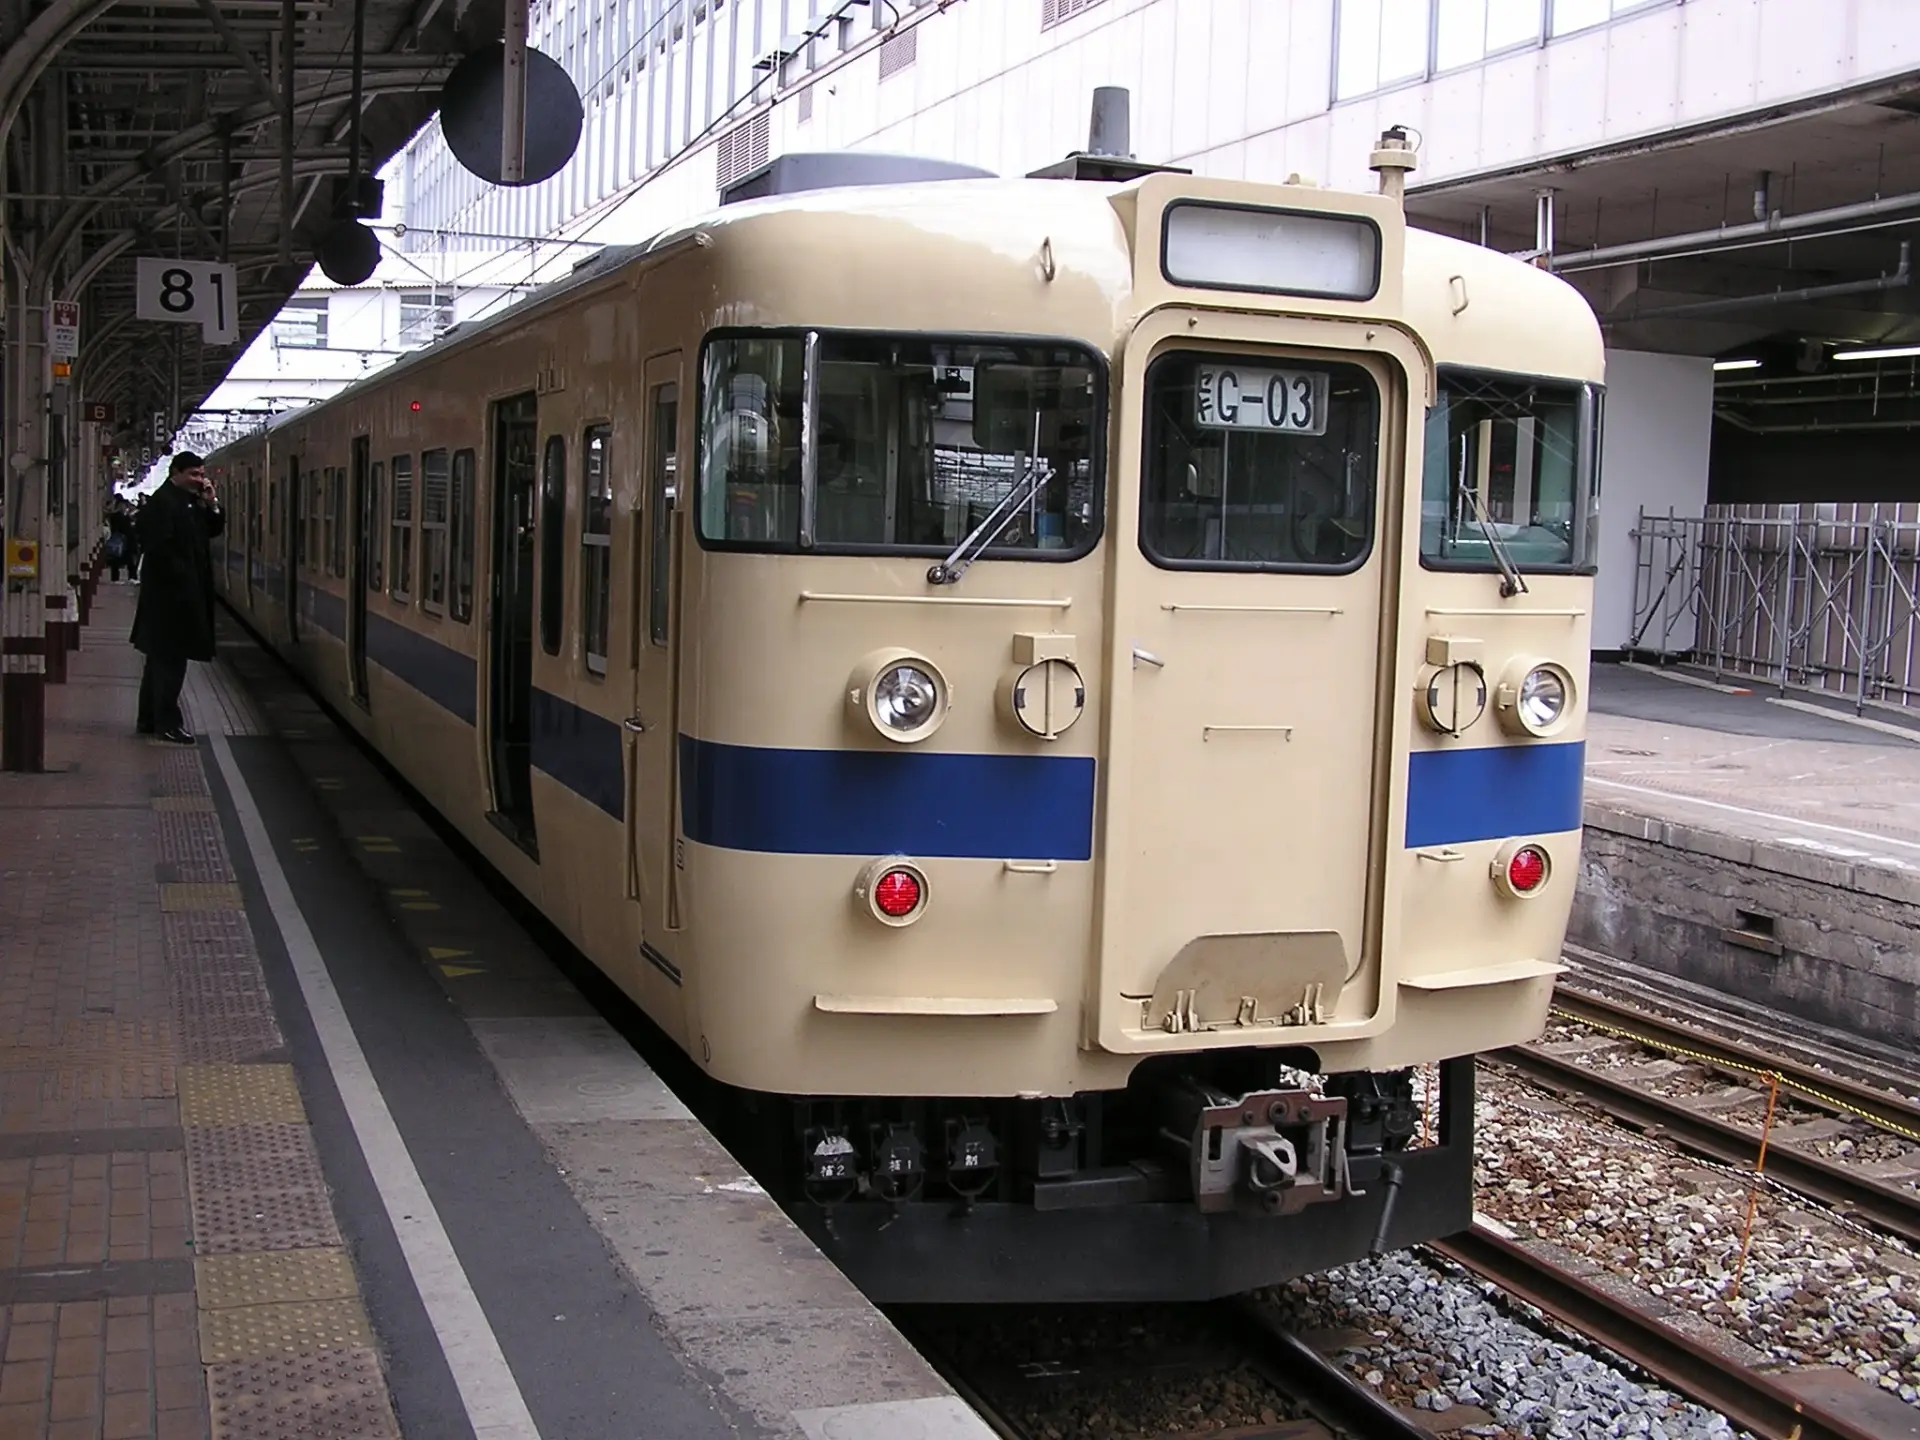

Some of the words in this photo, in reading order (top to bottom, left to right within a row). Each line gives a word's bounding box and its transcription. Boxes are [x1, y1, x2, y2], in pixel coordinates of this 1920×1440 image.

[160, 268, 195, 313] 8
[94, 406, 106, 420] 6
[1217, 370, 1312, 428] G-03
